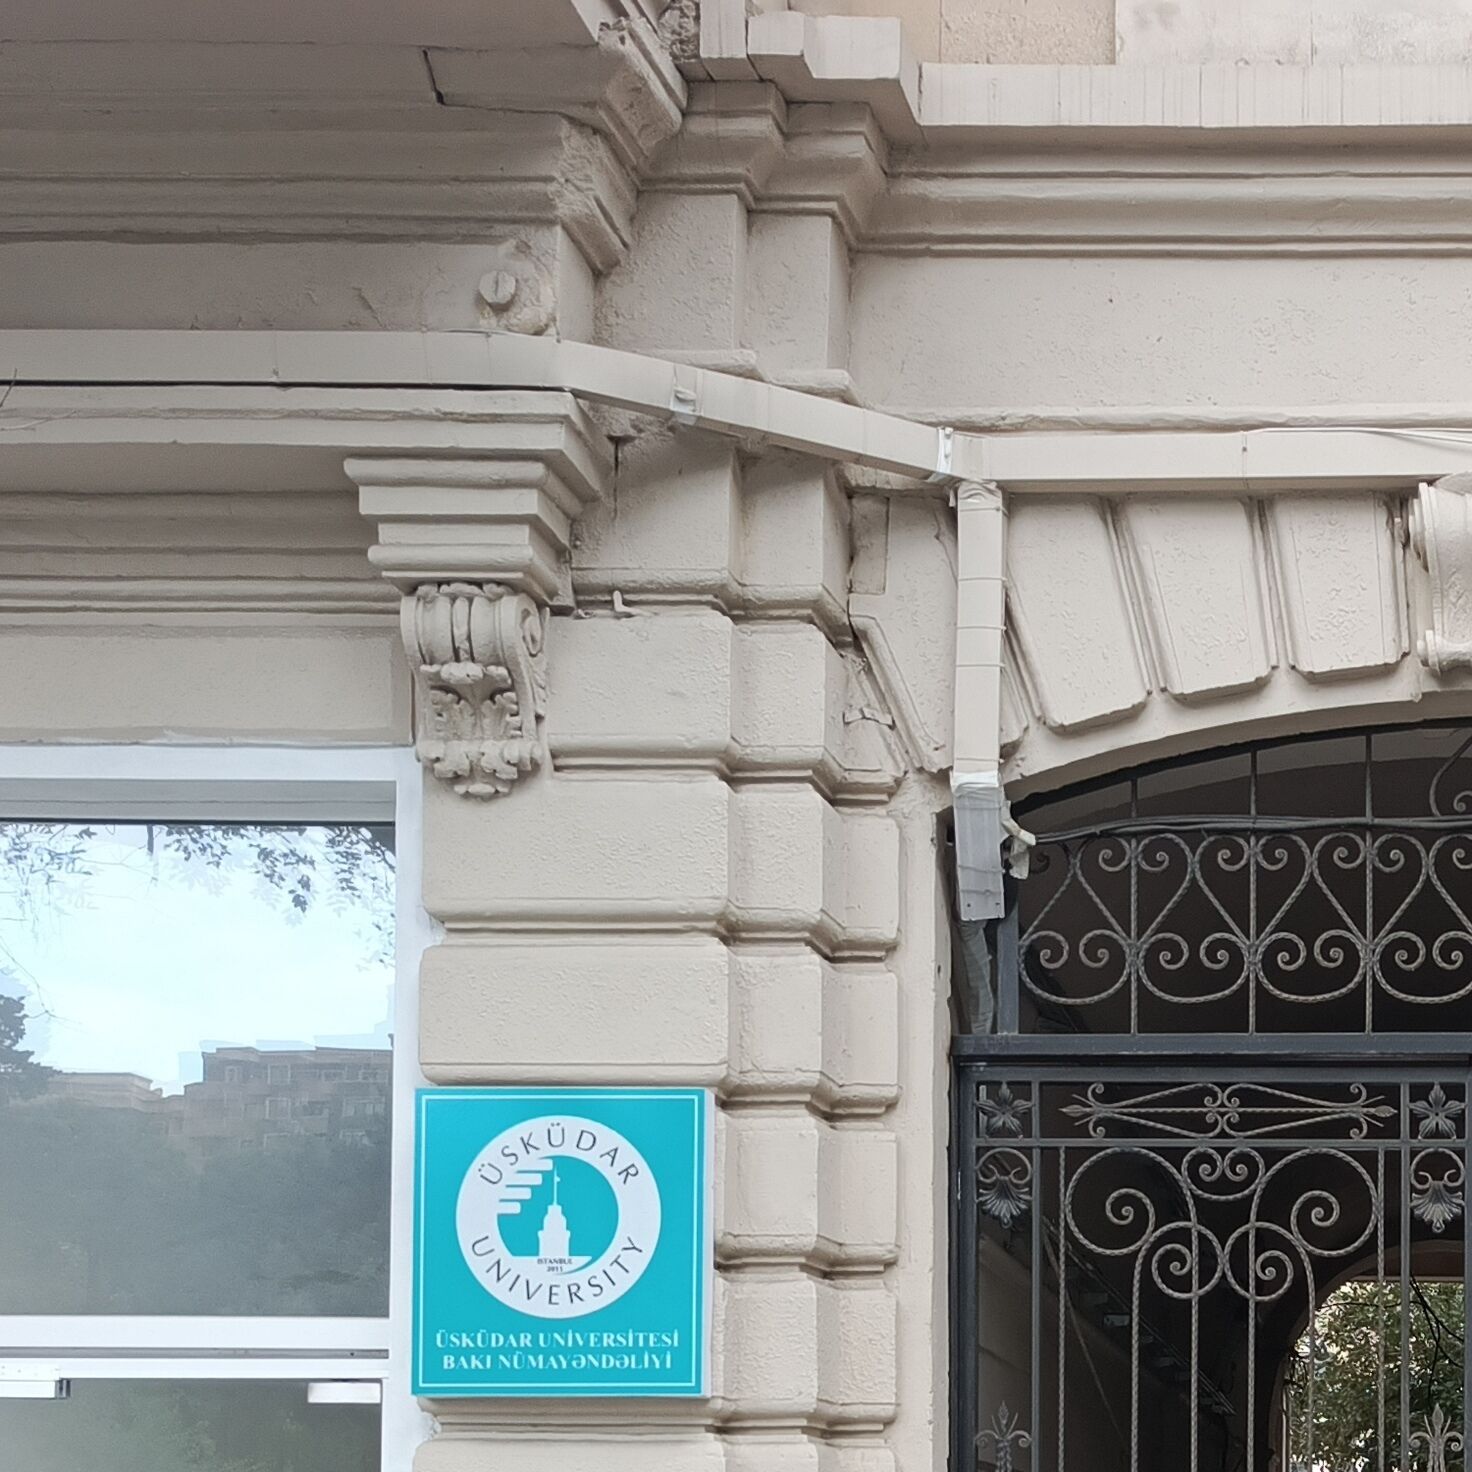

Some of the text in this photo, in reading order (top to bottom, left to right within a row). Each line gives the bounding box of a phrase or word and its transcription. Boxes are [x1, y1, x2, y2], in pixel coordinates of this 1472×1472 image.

[478, 1122, 639, 1186] ÜSKÜDAR
[471, 1236, 643, 1305] UNIVERSITY
[436, 1328, 679, 1348] ÜSKÜDAR UNİVERSİTESİ
[443, 1350, 672, 1370] BAKI NÜMAYƏNDƏLİYİ
